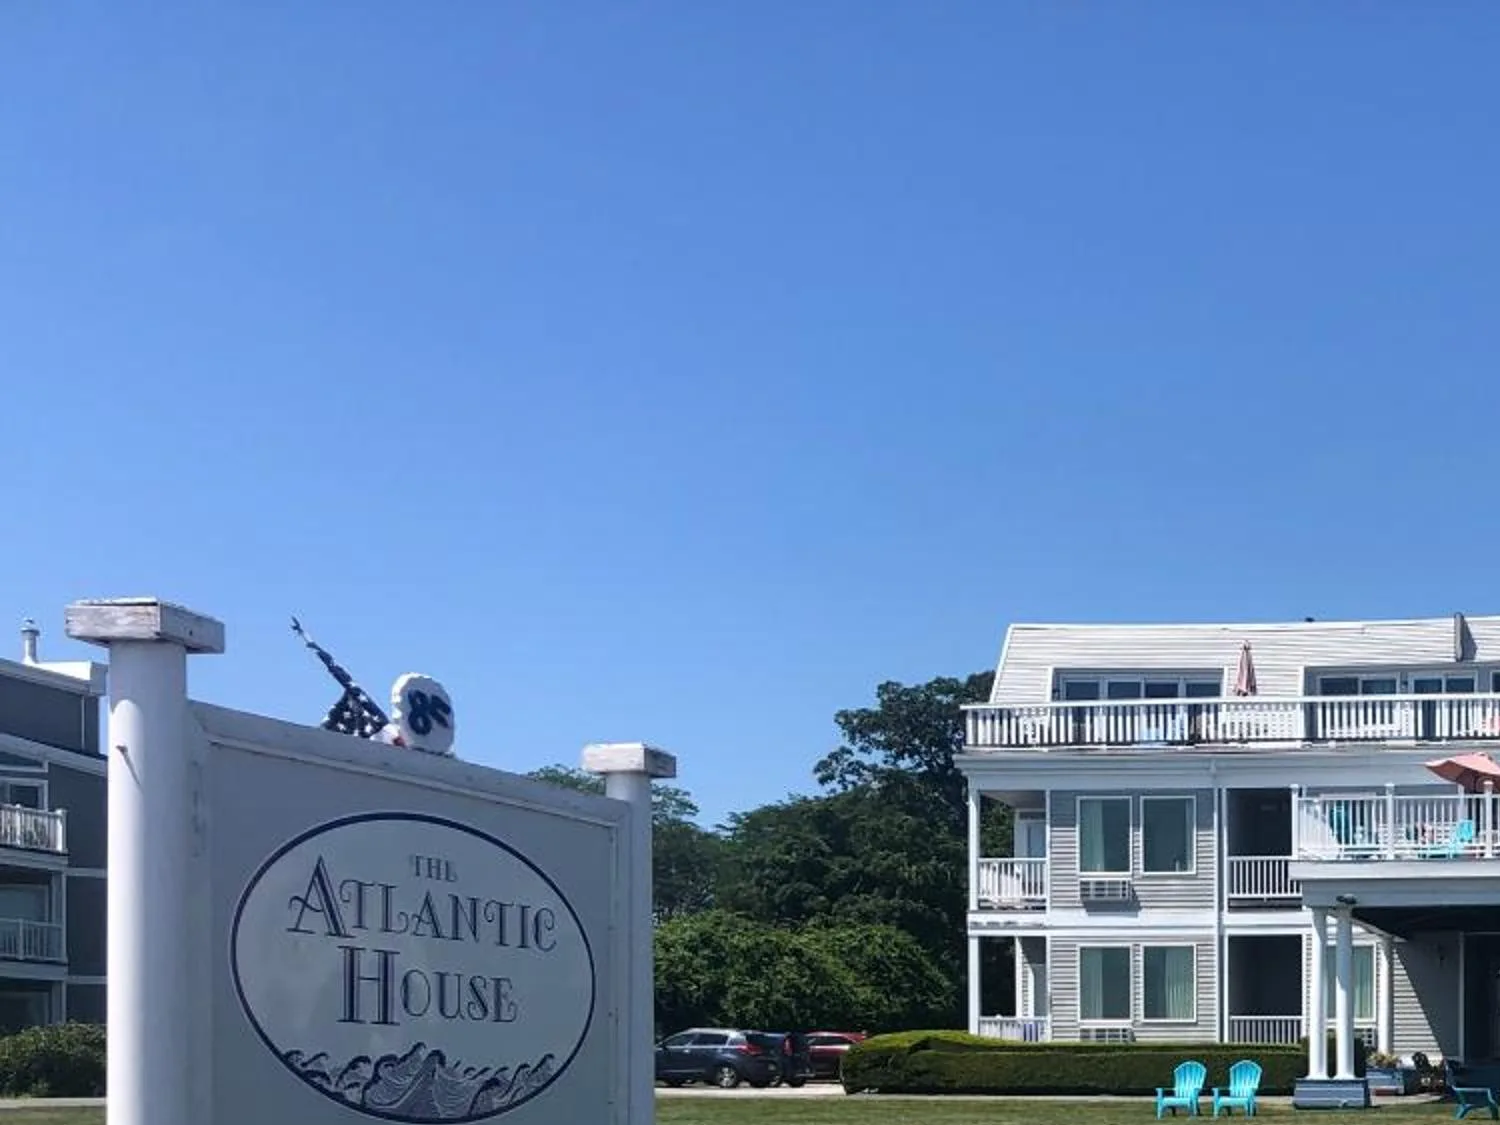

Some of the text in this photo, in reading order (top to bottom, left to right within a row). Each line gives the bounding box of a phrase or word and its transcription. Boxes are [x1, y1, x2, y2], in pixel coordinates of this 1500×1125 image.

[286, 855, 558, 952] ATLANTIC
[410, 854, 458, 883] THE
[337, 946, 518, 1026] HOUSE
